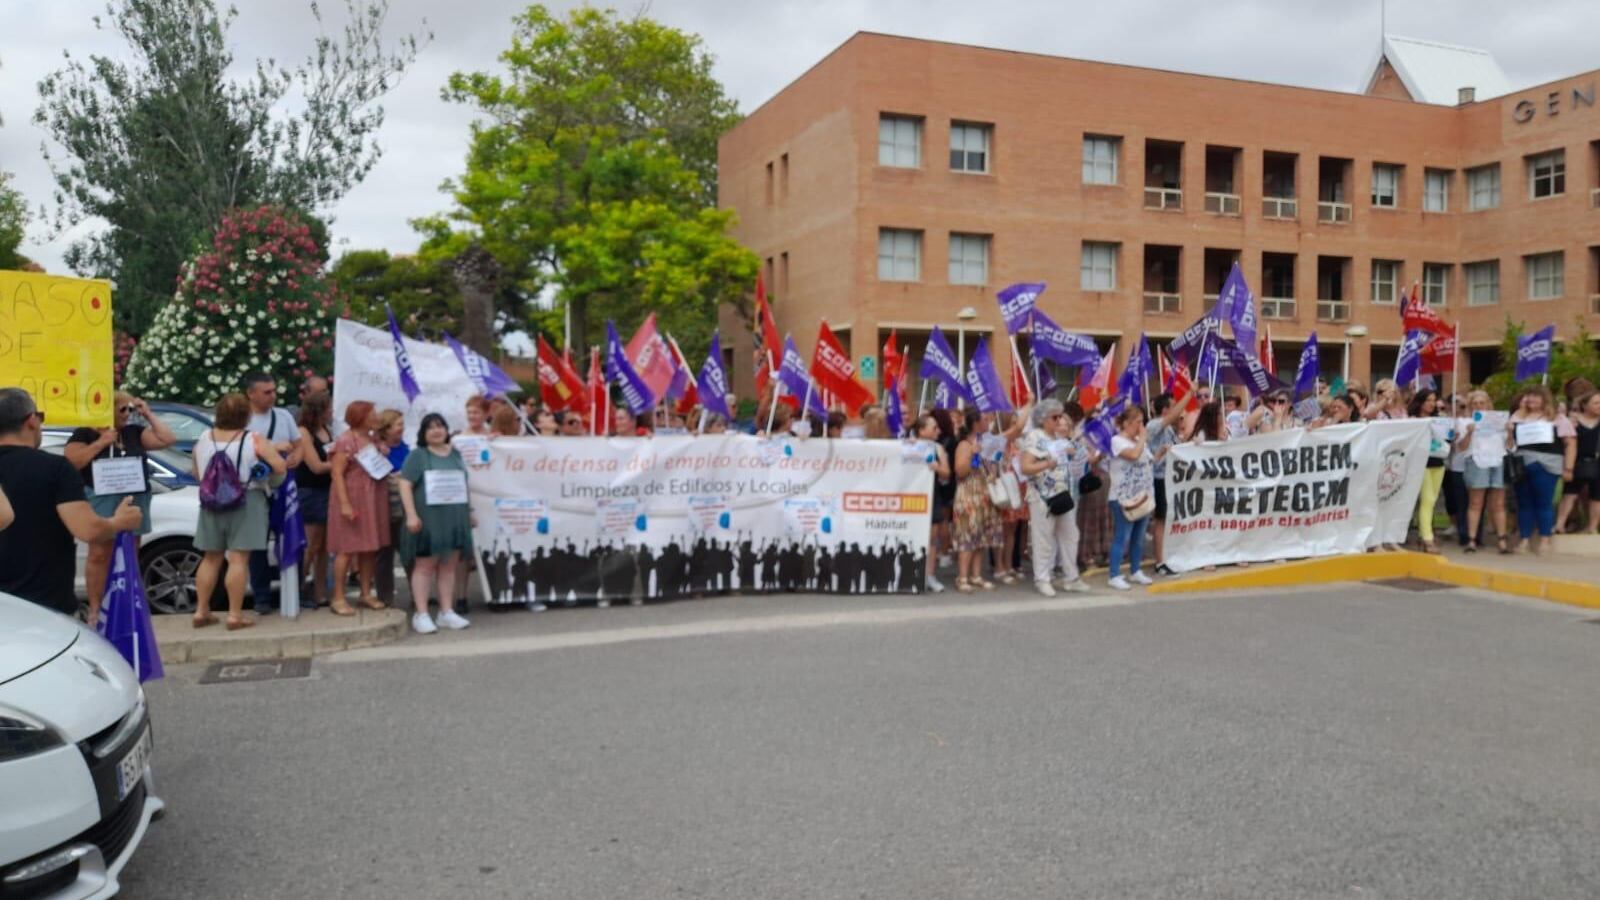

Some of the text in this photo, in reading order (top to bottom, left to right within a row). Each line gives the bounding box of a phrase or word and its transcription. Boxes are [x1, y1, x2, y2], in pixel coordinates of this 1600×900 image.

[1512, 84, 1594, 124] GEN
[0, 281, 109, 327] ASO
[505, 455, 525, 472] la
[534, 453, 618, 476] defensa
[627, 454, 657, 473] del
[664, 453, 731, 475] empleo
[1241, 442, 1359, 480] COBREM,
[561, 477, 809, 499] Limpieza de Edificios y Locales
[845, 495, 901, 511] CCOO
[1173, 487, 1205, 521] NO
[1213, 477, 1351, 516] NETEGEM
